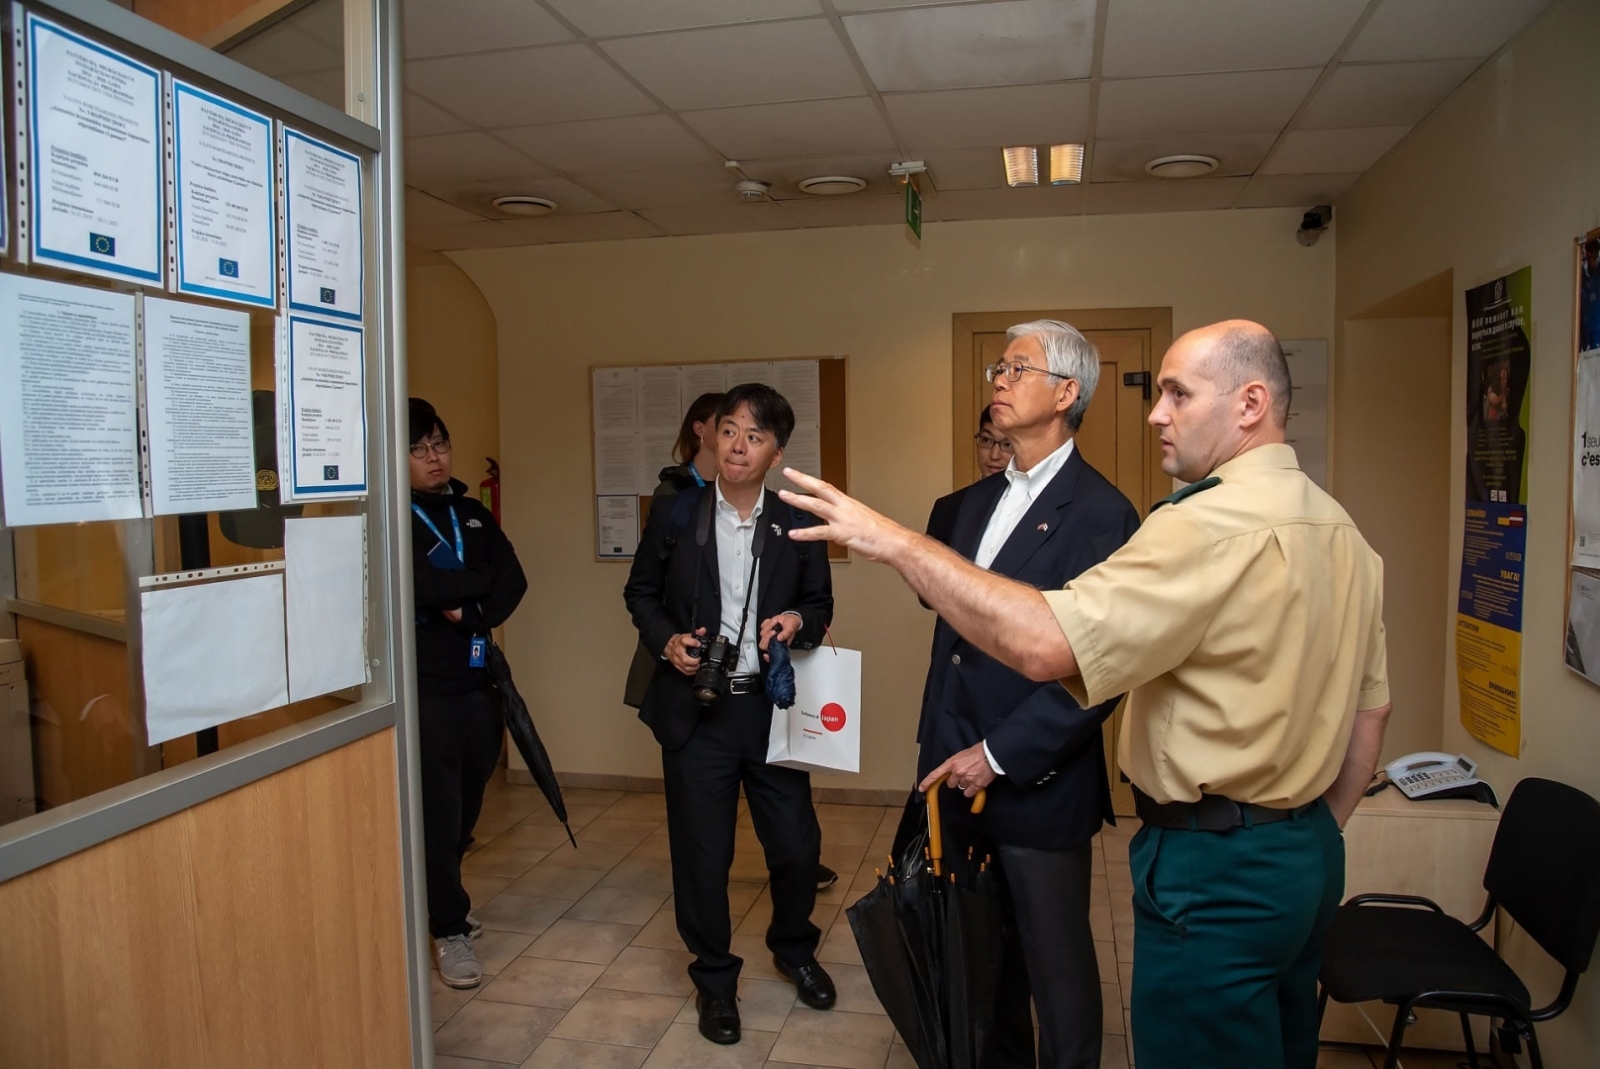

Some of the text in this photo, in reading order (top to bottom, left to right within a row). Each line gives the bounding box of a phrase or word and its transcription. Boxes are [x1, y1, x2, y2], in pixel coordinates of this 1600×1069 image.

[1500, 570, 1520, 582] УВАГА!
[1488, 681, 1516, 698] ВНИМАНИЕ!
[822, 714, 838, 722] Japan
